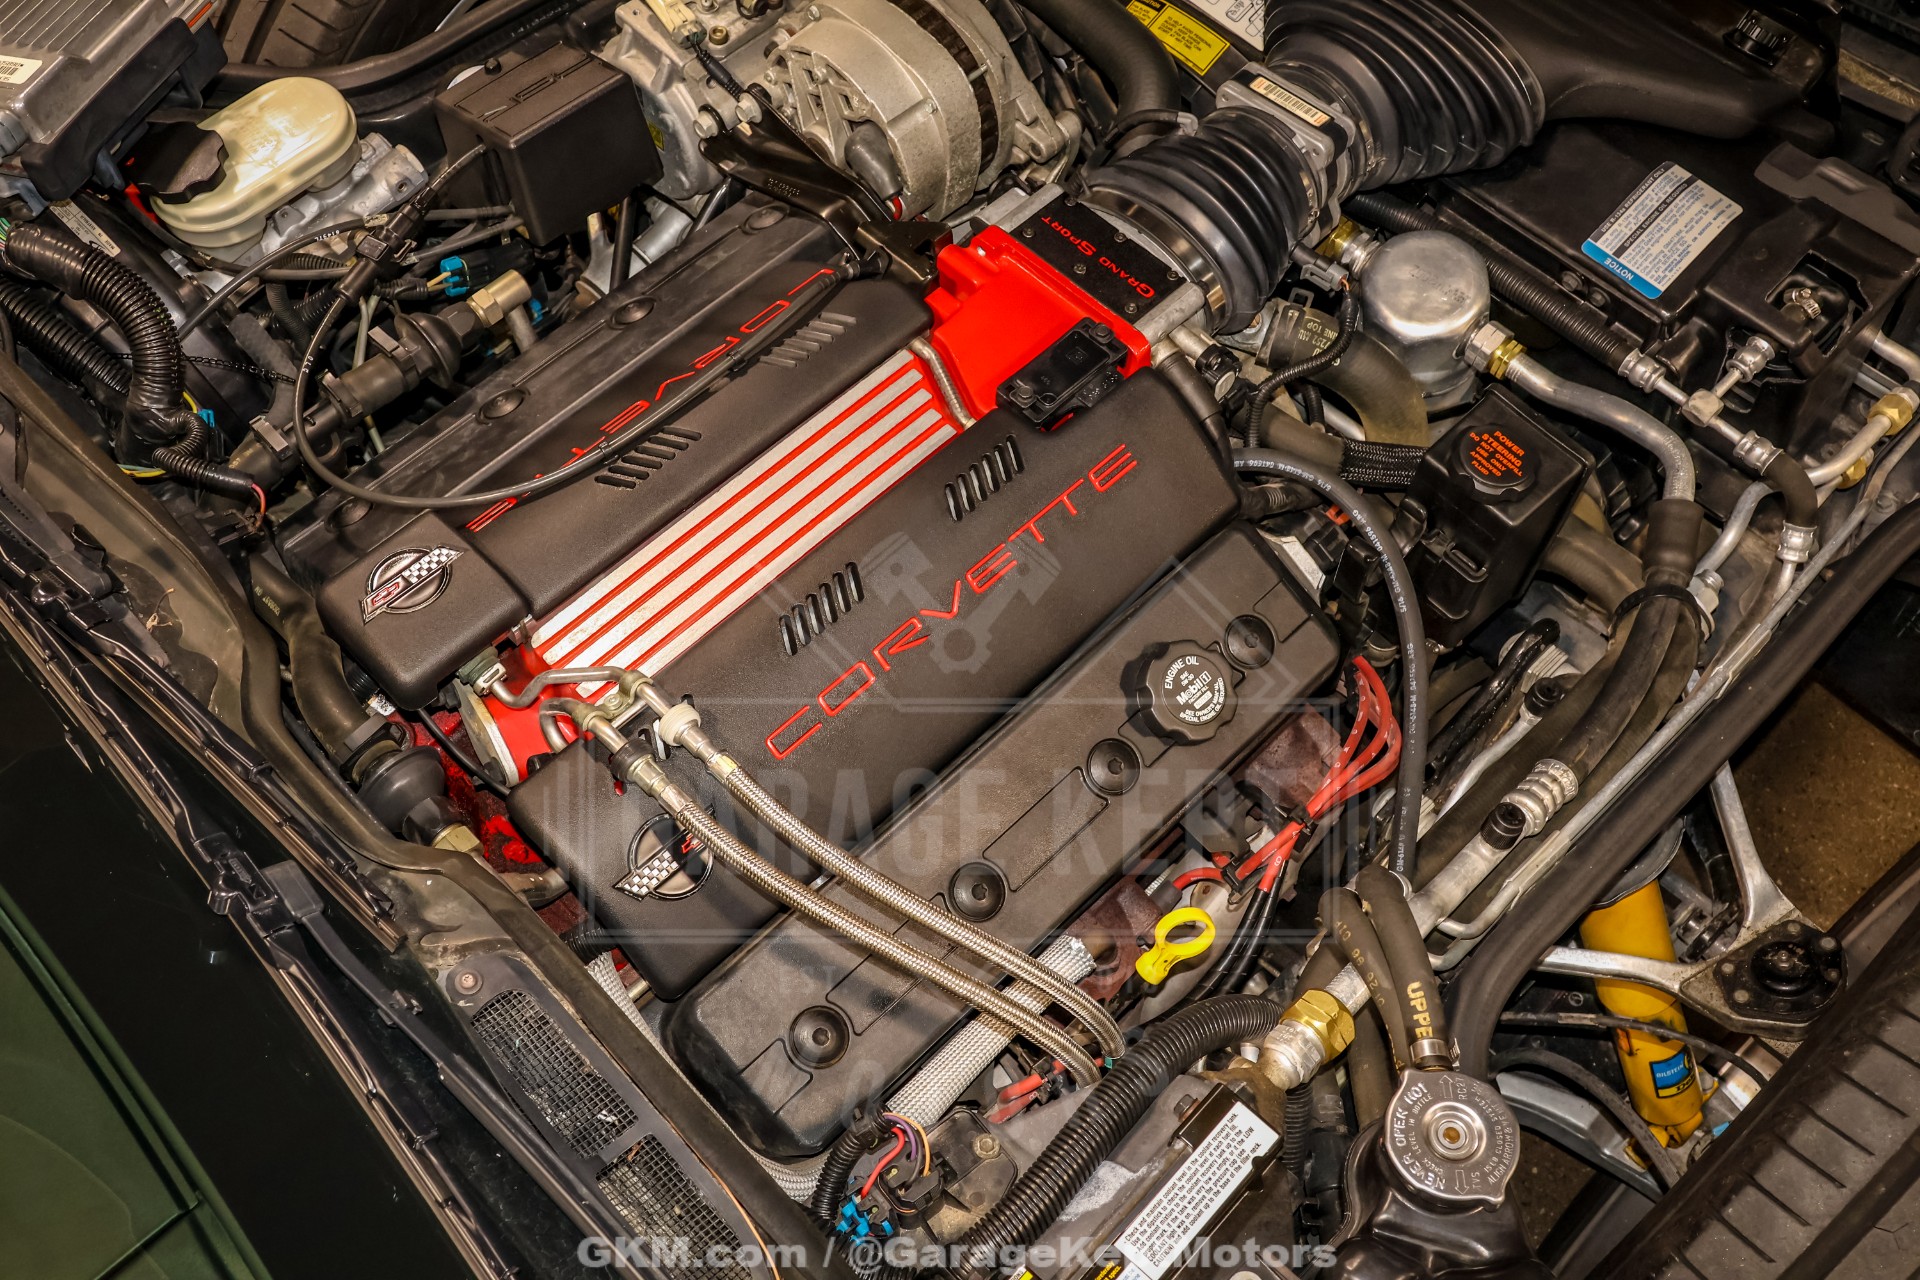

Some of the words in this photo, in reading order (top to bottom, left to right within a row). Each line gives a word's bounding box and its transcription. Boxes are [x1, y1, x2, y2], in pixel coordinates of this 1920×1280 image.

[1623, 227, 1643, 247] SPECIAL
[1641, 210, 1660, 228] ENGINE
[1658, 203, 1667, 211] OIL
[1603, 256, 1634, 281] NOTICE
[1306, 320, 1323, 333] TOP
[1470, 432, 1480, 441] DO
[1481, 442, 1494, 452] NOT
[1495, 454, 1522, 476] OVERFILL
[1482, 434, 1522, 467] STEERING
[1494, 431, 1524, 456] POWER
[1470, 452, 1501, 476] APPROVED
[1472, 460, 1489, 475] FLUID
[1476, 447, 1489, 457] USE
[1491, 459, 1506, 470] ONLY
[766, 443, 1138, 760] CORVETTE
[1164, 658, 1185, 688] ENGINE
[1185, 656, 1199, 665] OIL
[1175, 678, 1203, 704] Mobil
[1200, 710, 1216, 721] ENGINE
[1403, 980, 1435, 1041] UPPE
[1655, 1063, 1683, 1078] BILSTEIN
[1403, 1081, 1427, 1104] HOT
[1412, 1093, 1432, 1114] BOTTLE
[1408, 1118, 1415, 1126] IN
[1474, 1097, 1498, 1121] SYSTEM
[1393, 1107, 1408, 1146] OPEN
[1494, 1125, 1502, 1154] CLOSED
[1408, 1131, 1421, 1154] LEVEL
[1170, 1214, 1179, 1224] the
[1176, 1204, 1188, 1216] tank
[1187, 1195, 1196, 1205] was
[1195, 1184, 1206, 1196] very
[1203, 1175, 1212, 1185] low
[1236, 1137, 1245, 1146] the
[1243, 1126, 1255, 1138] LOW
[1402, 1152, 1446, 1189] NEVER
[1421, 1157, 1443, 1175] CHECK
[1486, 1164, 1506, 1184] ALIGN
[1124, 1225, 1139, 1241] Check
[1136, 1216, 1147, 1227] and
[1144, 1197, 1164, 1218] maintain
[1161, 1181, 1178, 1199] coolant
[1175, 1169, 1187, 1182] level
[1189, 1156, 1199, 1166] the
[1196, 1140, 1213, 1158] coolant
[1211, 1123, 1229, 1143] recovery
[1130, 1235, 1141, 1246] Use
[1138, 1227, 1148, 1237] the
[1145, 1210, 1163, 1229] dipstick
[1165, 1191, 1179, 1206] check
[1177, 1183, 1186, 1192] the
[1183, 1167, 1200, 1185] coolant
[1197, 1156, 1209, 1168] level
[1212, 1139, 1224, 1152] each
[1221, 1130, 1231, 1141] fuel
[1135, 1240, 1146, 1252] Add
[1144, 1224, 1161, 1242] coolant
[1158, 1206, 1175, 1225] mixture
[1178, 1193, 1187, 1202] the
[1185, 1177, 1201, 1194] coolant
[1200, 1158, 1218, 1179] recovery
[1215, 1148, 1226, 1159] tank
[1225, 1142, 1232, 1150] up
[1234, 1128, 1243, 1137] the
[1180, 1224, 1190, 1235] add
[1187, 1208, 1204, 1226] coolant
[1203, 1202, 1210, 1210] up
[1212, 1188, 1221, 1197] the
[1219, 1177, 1231, 1189] base
[1233, 1163, 1242, 1173] the
[1240, 1152, 1251, 1165] filler
[1147, 1239, 1168, 1262] COOLANT
[1166, 1228, 1178, 1241] light
[1176, 1219, 1185, 1229] was
[1191, 1194, 1207, 1211] remove
[1204, 1185, 1213, 1195] the
[1212, 1167, 1230, 1187] pressure
[1228, 1158, 1238, 1168] cap
